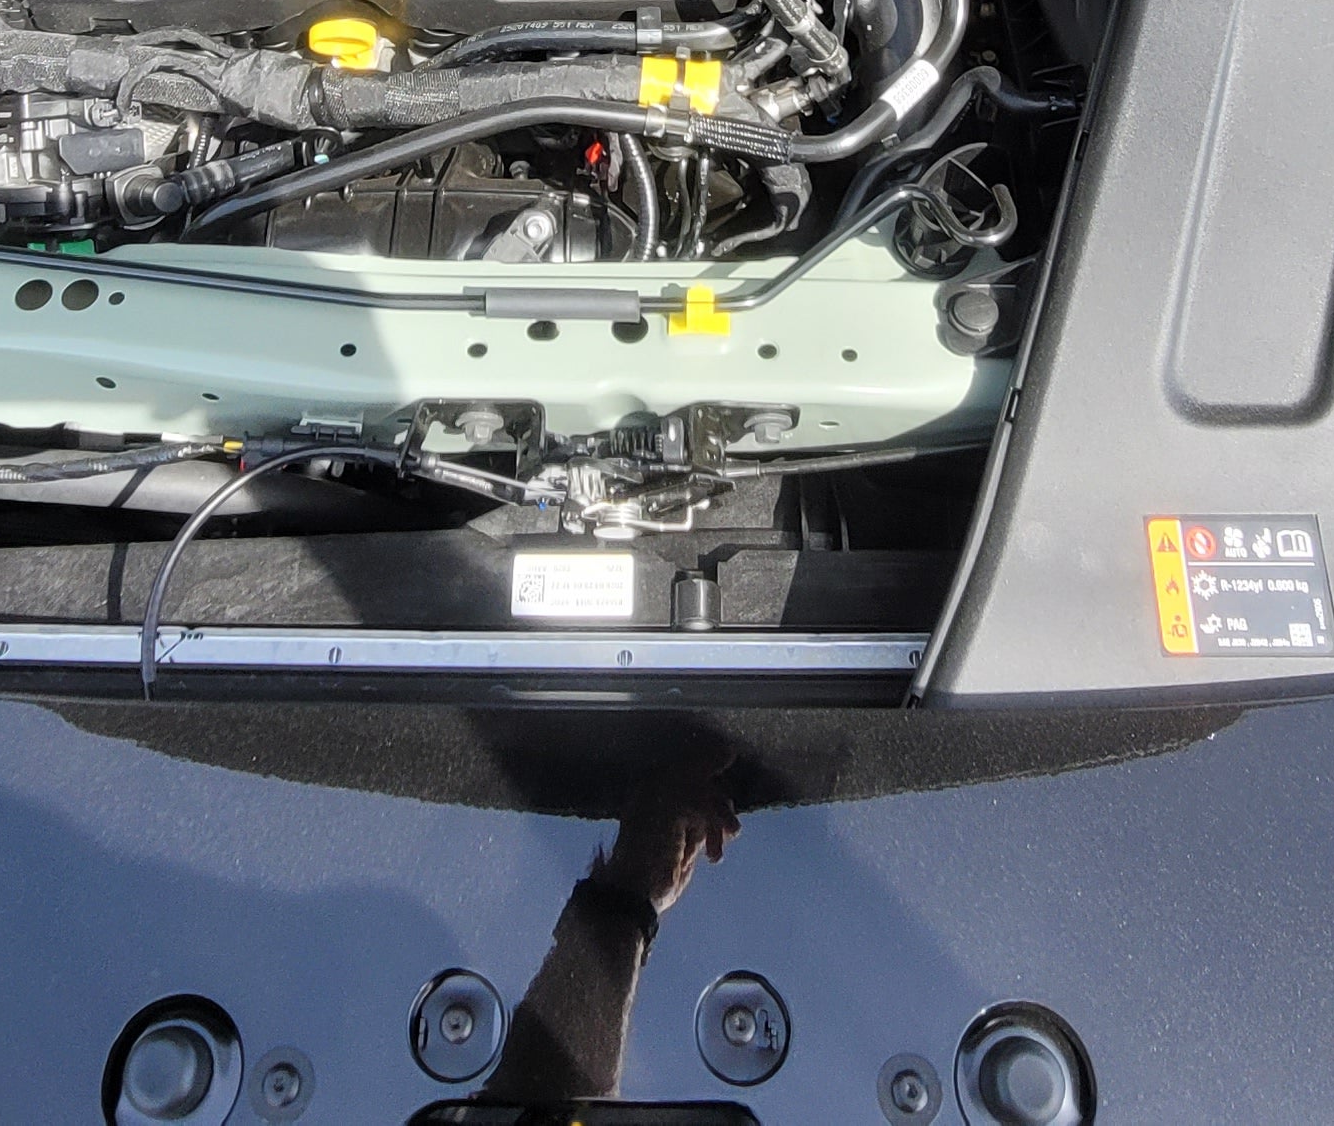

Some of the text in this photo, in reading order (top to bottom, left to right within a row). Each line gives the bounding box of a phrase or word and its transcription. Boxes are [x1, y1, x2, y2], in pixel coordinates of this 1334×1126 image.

[1224, 547, 1248, 558] AUTO
[1220, 579, 1264, 593] R-1234yf
[1295, 579, 1309, 594] kg
